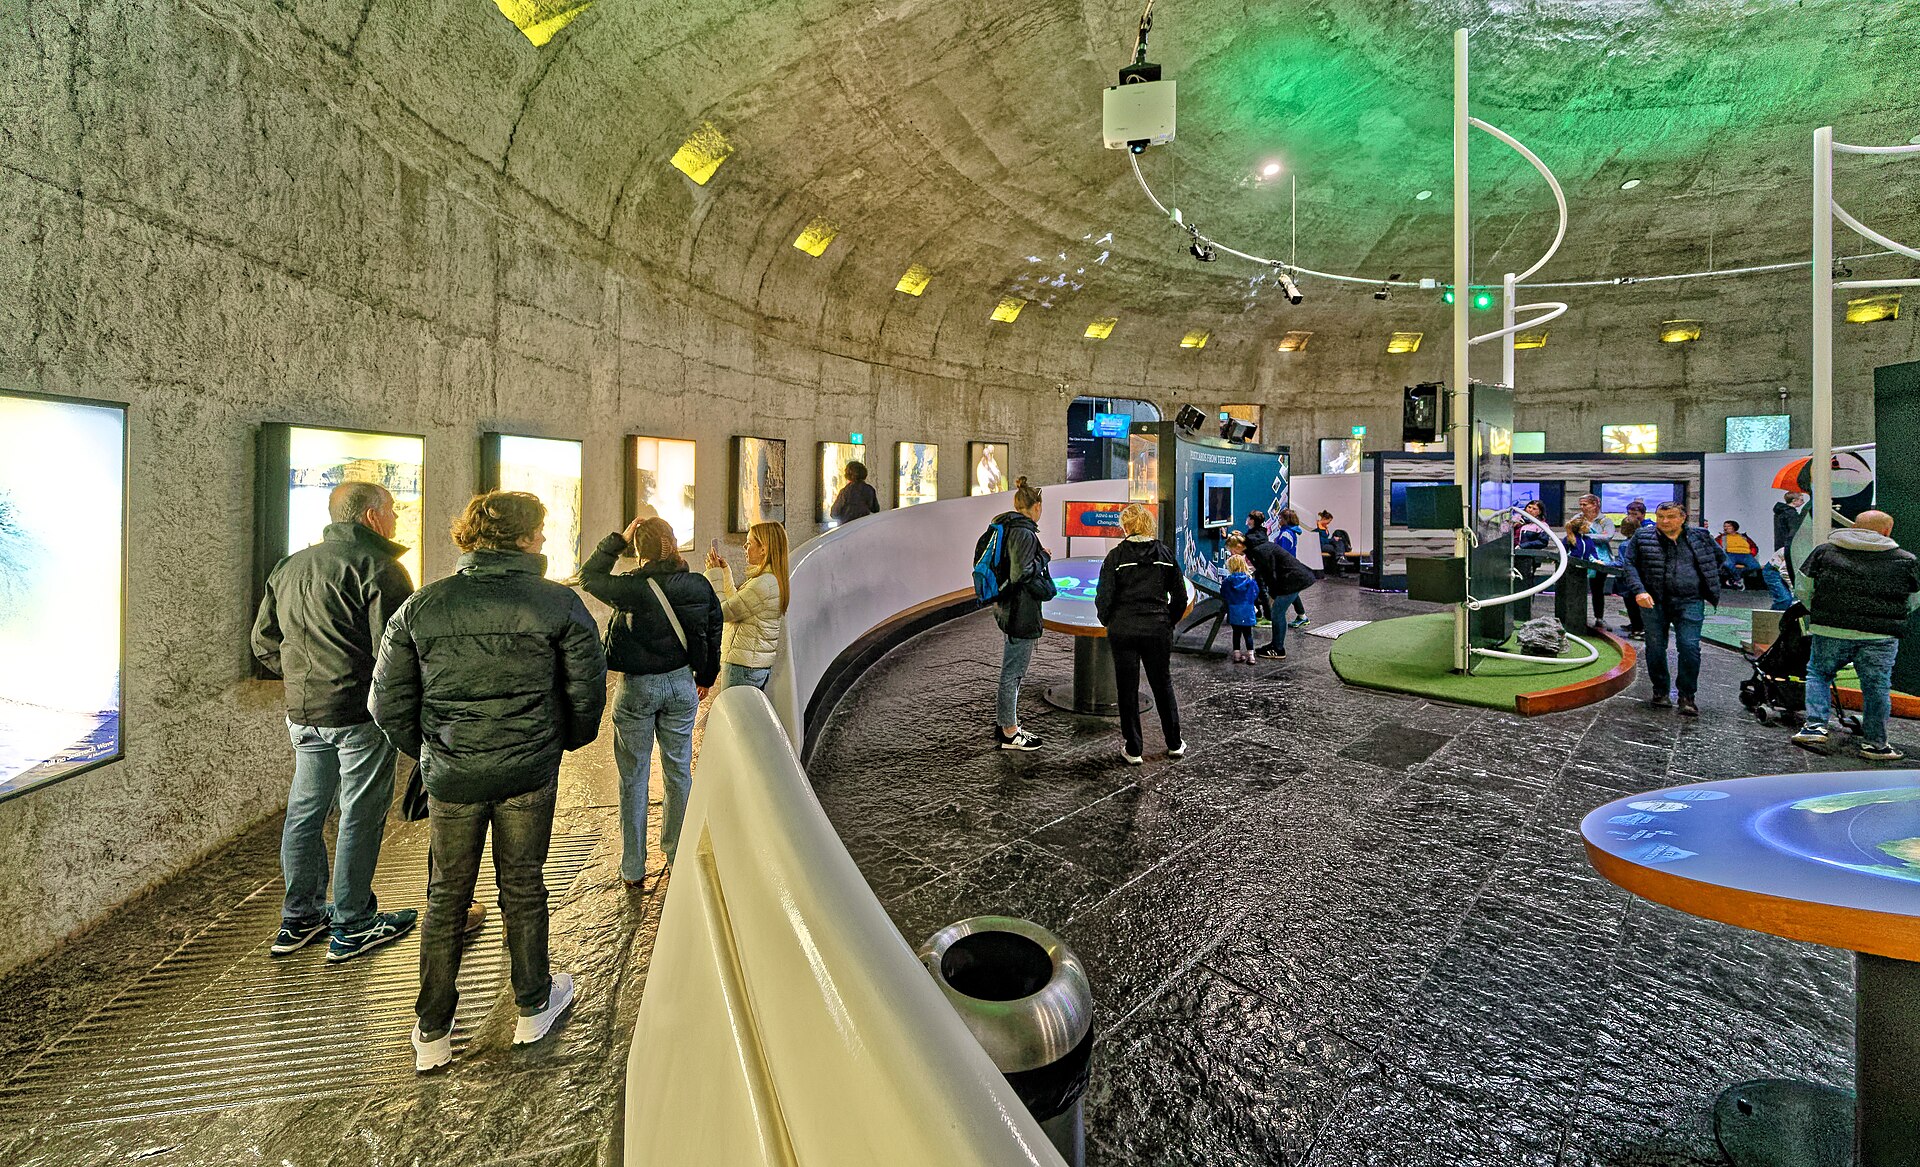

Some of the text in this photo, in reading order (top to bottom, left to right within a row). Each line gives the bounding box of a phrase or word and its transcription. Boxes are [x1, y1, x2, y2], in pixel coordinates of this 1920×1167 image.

[1206, 454, 1217, 464] FROM
[1225, 456, 1237, 465] EDGE
[96, 740, 114, 750] Wave
